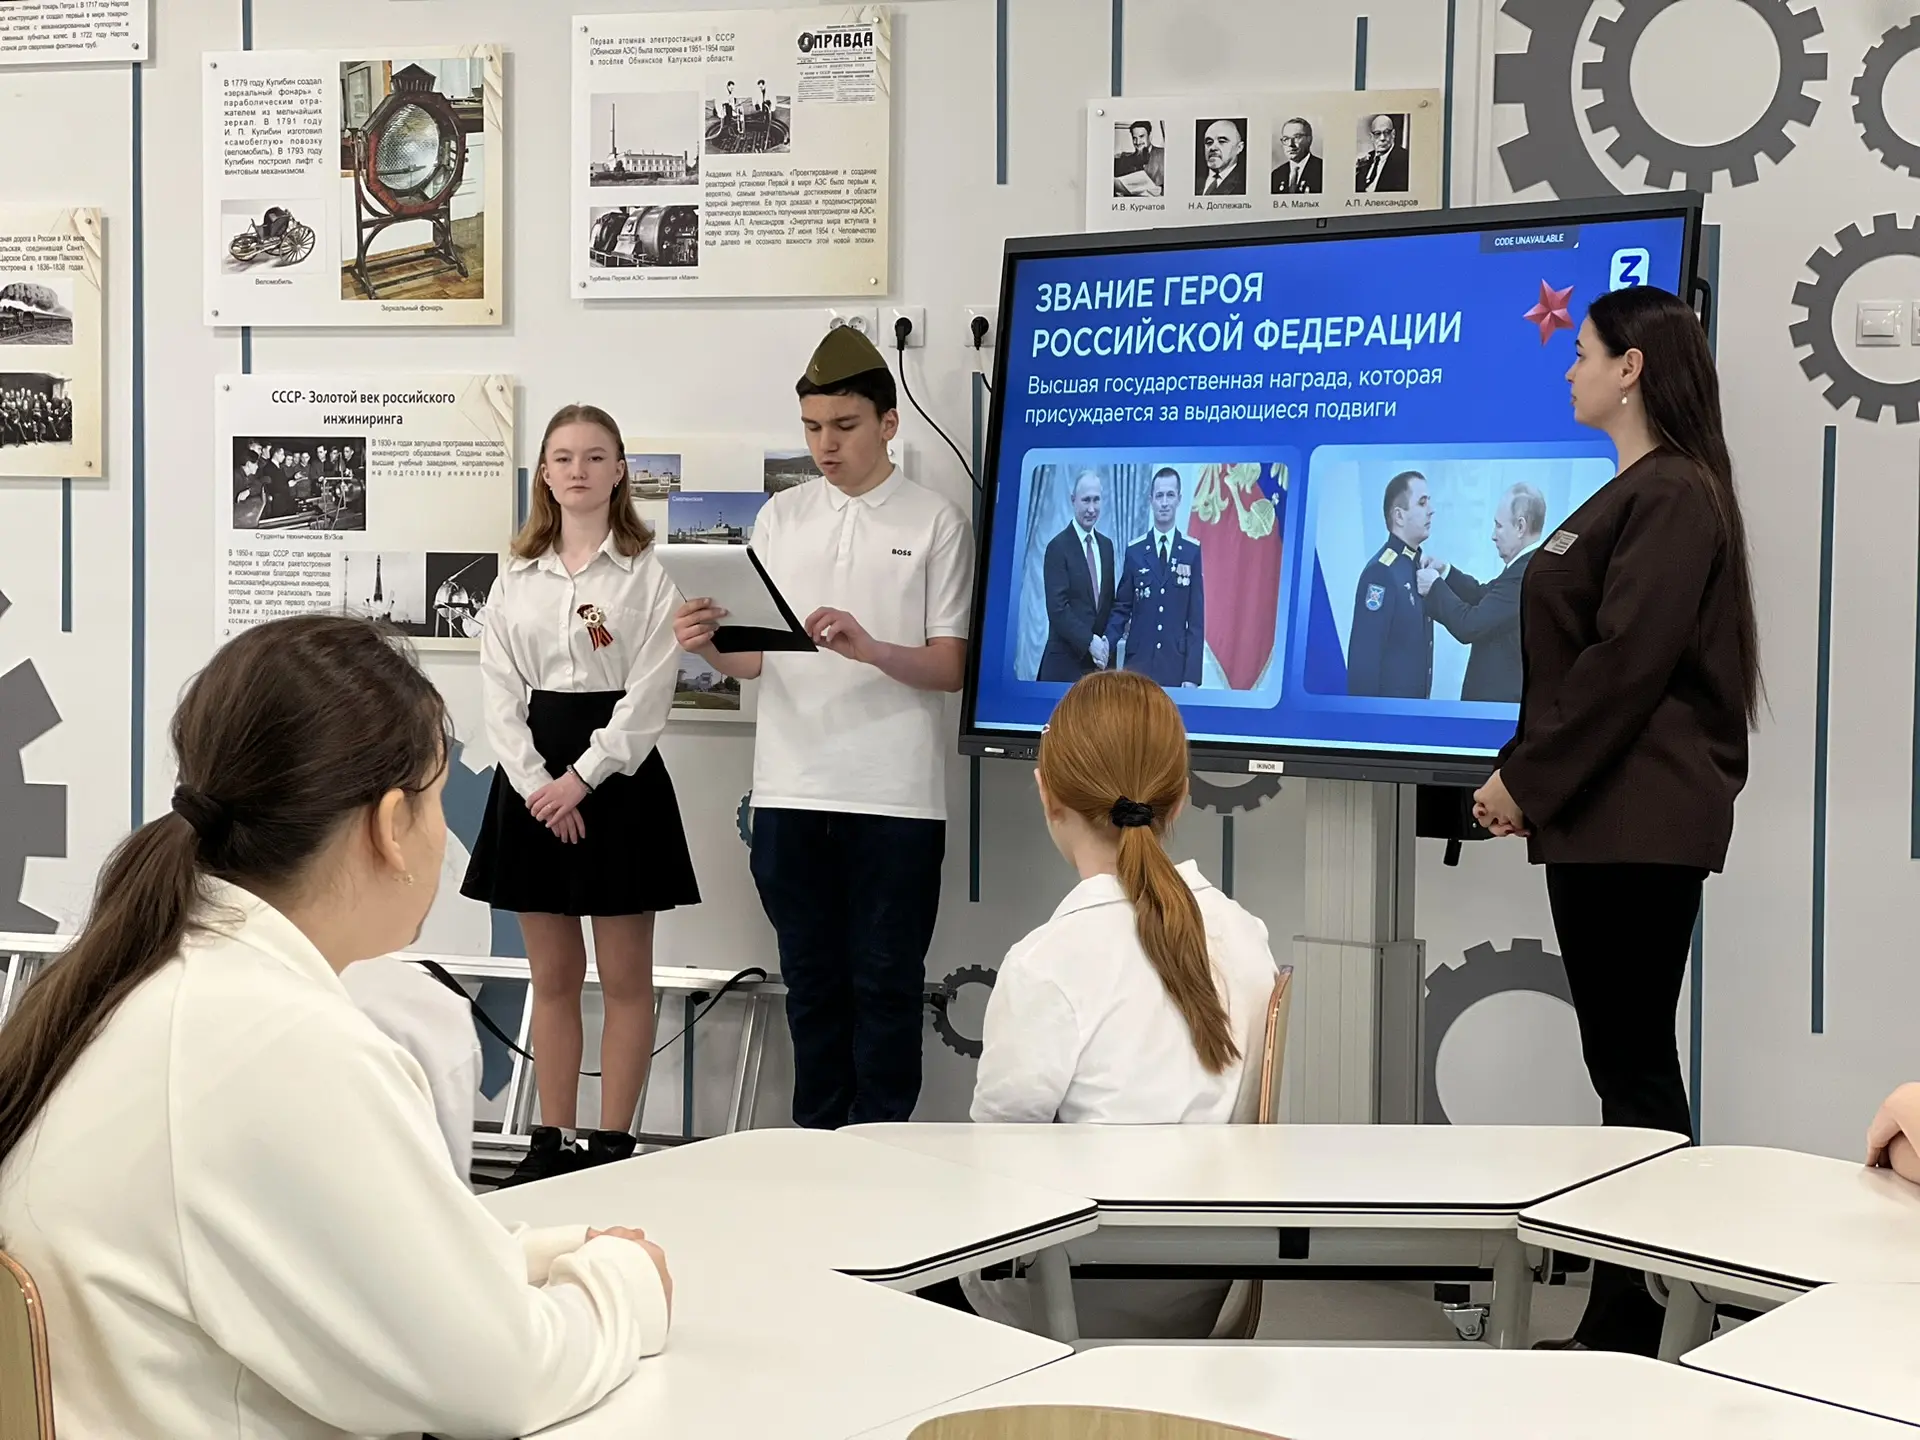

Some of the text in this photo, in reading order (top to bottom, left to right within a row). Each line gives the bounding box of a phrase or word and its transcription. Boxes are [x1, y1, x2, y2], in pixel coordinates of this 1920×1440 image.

[590, 37, 614, 46] Первая
[650, 36, 702, 44] электростанция
[715, 33, 735, 42] СССР
[814, 32, 873, 48] ПРАВДА
[590, 47, 622, 56] (Обнинская
[623, 47, 637, 55] АЭС)
[638, 46, 653, 54] была
[628, 56, 663, 64] Обнинское
[668, 55, 702, 65] Калужской
[706, 54, 735, 62] области.
[1112, 203, 1165, 212] И.В. Курчатов
[1206, 201, 1252, 210] Доллежаль
[1273, 200, 1320, 208] В.А. Малых
[1345, 199, 1418, 208] А.П. Александров
[1495, 233, 1564, 246] CODE UNAVAILABLE
[1036, 272, 1263, 314] ЗВАНИЕ ГЕРОЯ
[1032, 311, 1462, 358] РОССИЙСКОЙ ФЕДЕРАЦИИ
[1028, 368, 1442, 396] Высшая государственная награда, которая
[309, 390, 357, 403] Золотой
[360, 394, 380, 403] век
[383, 390, 455, 407] российского
[1026, 401, 1396, 427] присуждается за выдающиеся подвиги
[323, 415, 403, 428] инжиниринга
